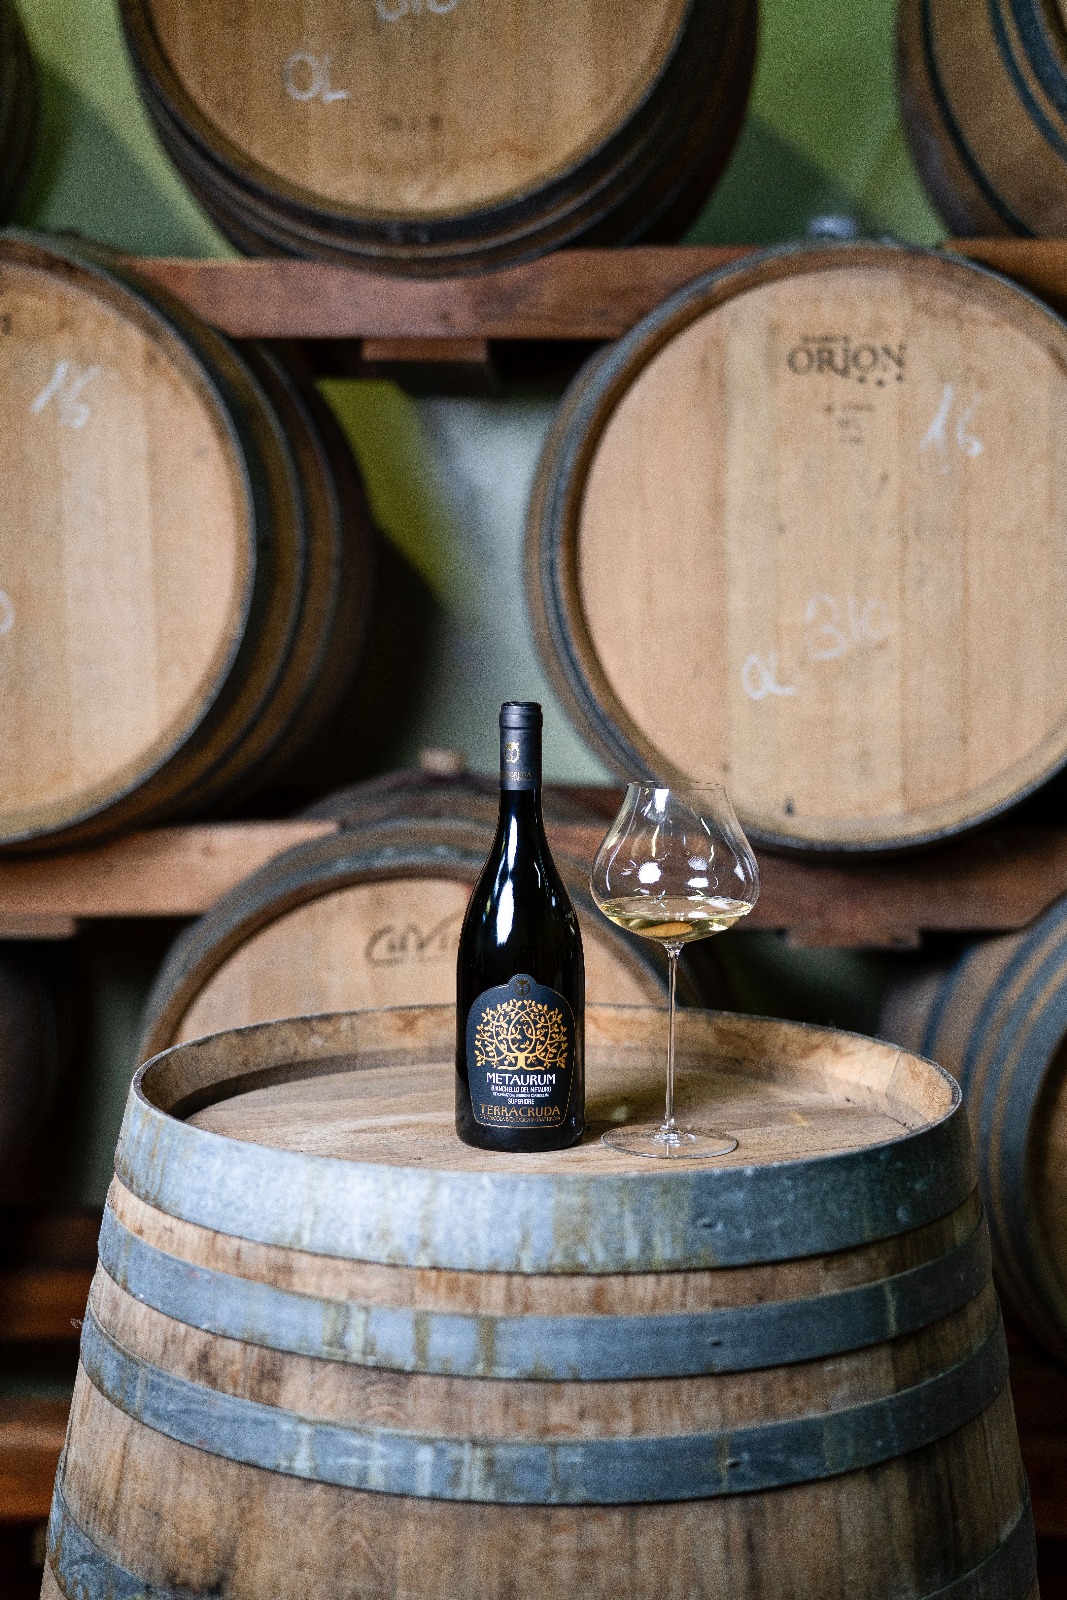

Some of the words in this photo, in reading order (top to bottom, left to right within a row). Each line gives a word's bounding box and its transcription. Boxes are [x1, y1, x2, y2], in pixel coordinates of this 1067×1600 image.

[787, 336, 906, 379] ORION
[486, 1072, 556, 1085] METAURUM
[507, 1097, 535, 1105] SUPERIORE
[479, 1103, 561, 1117] TERRACRUDA
